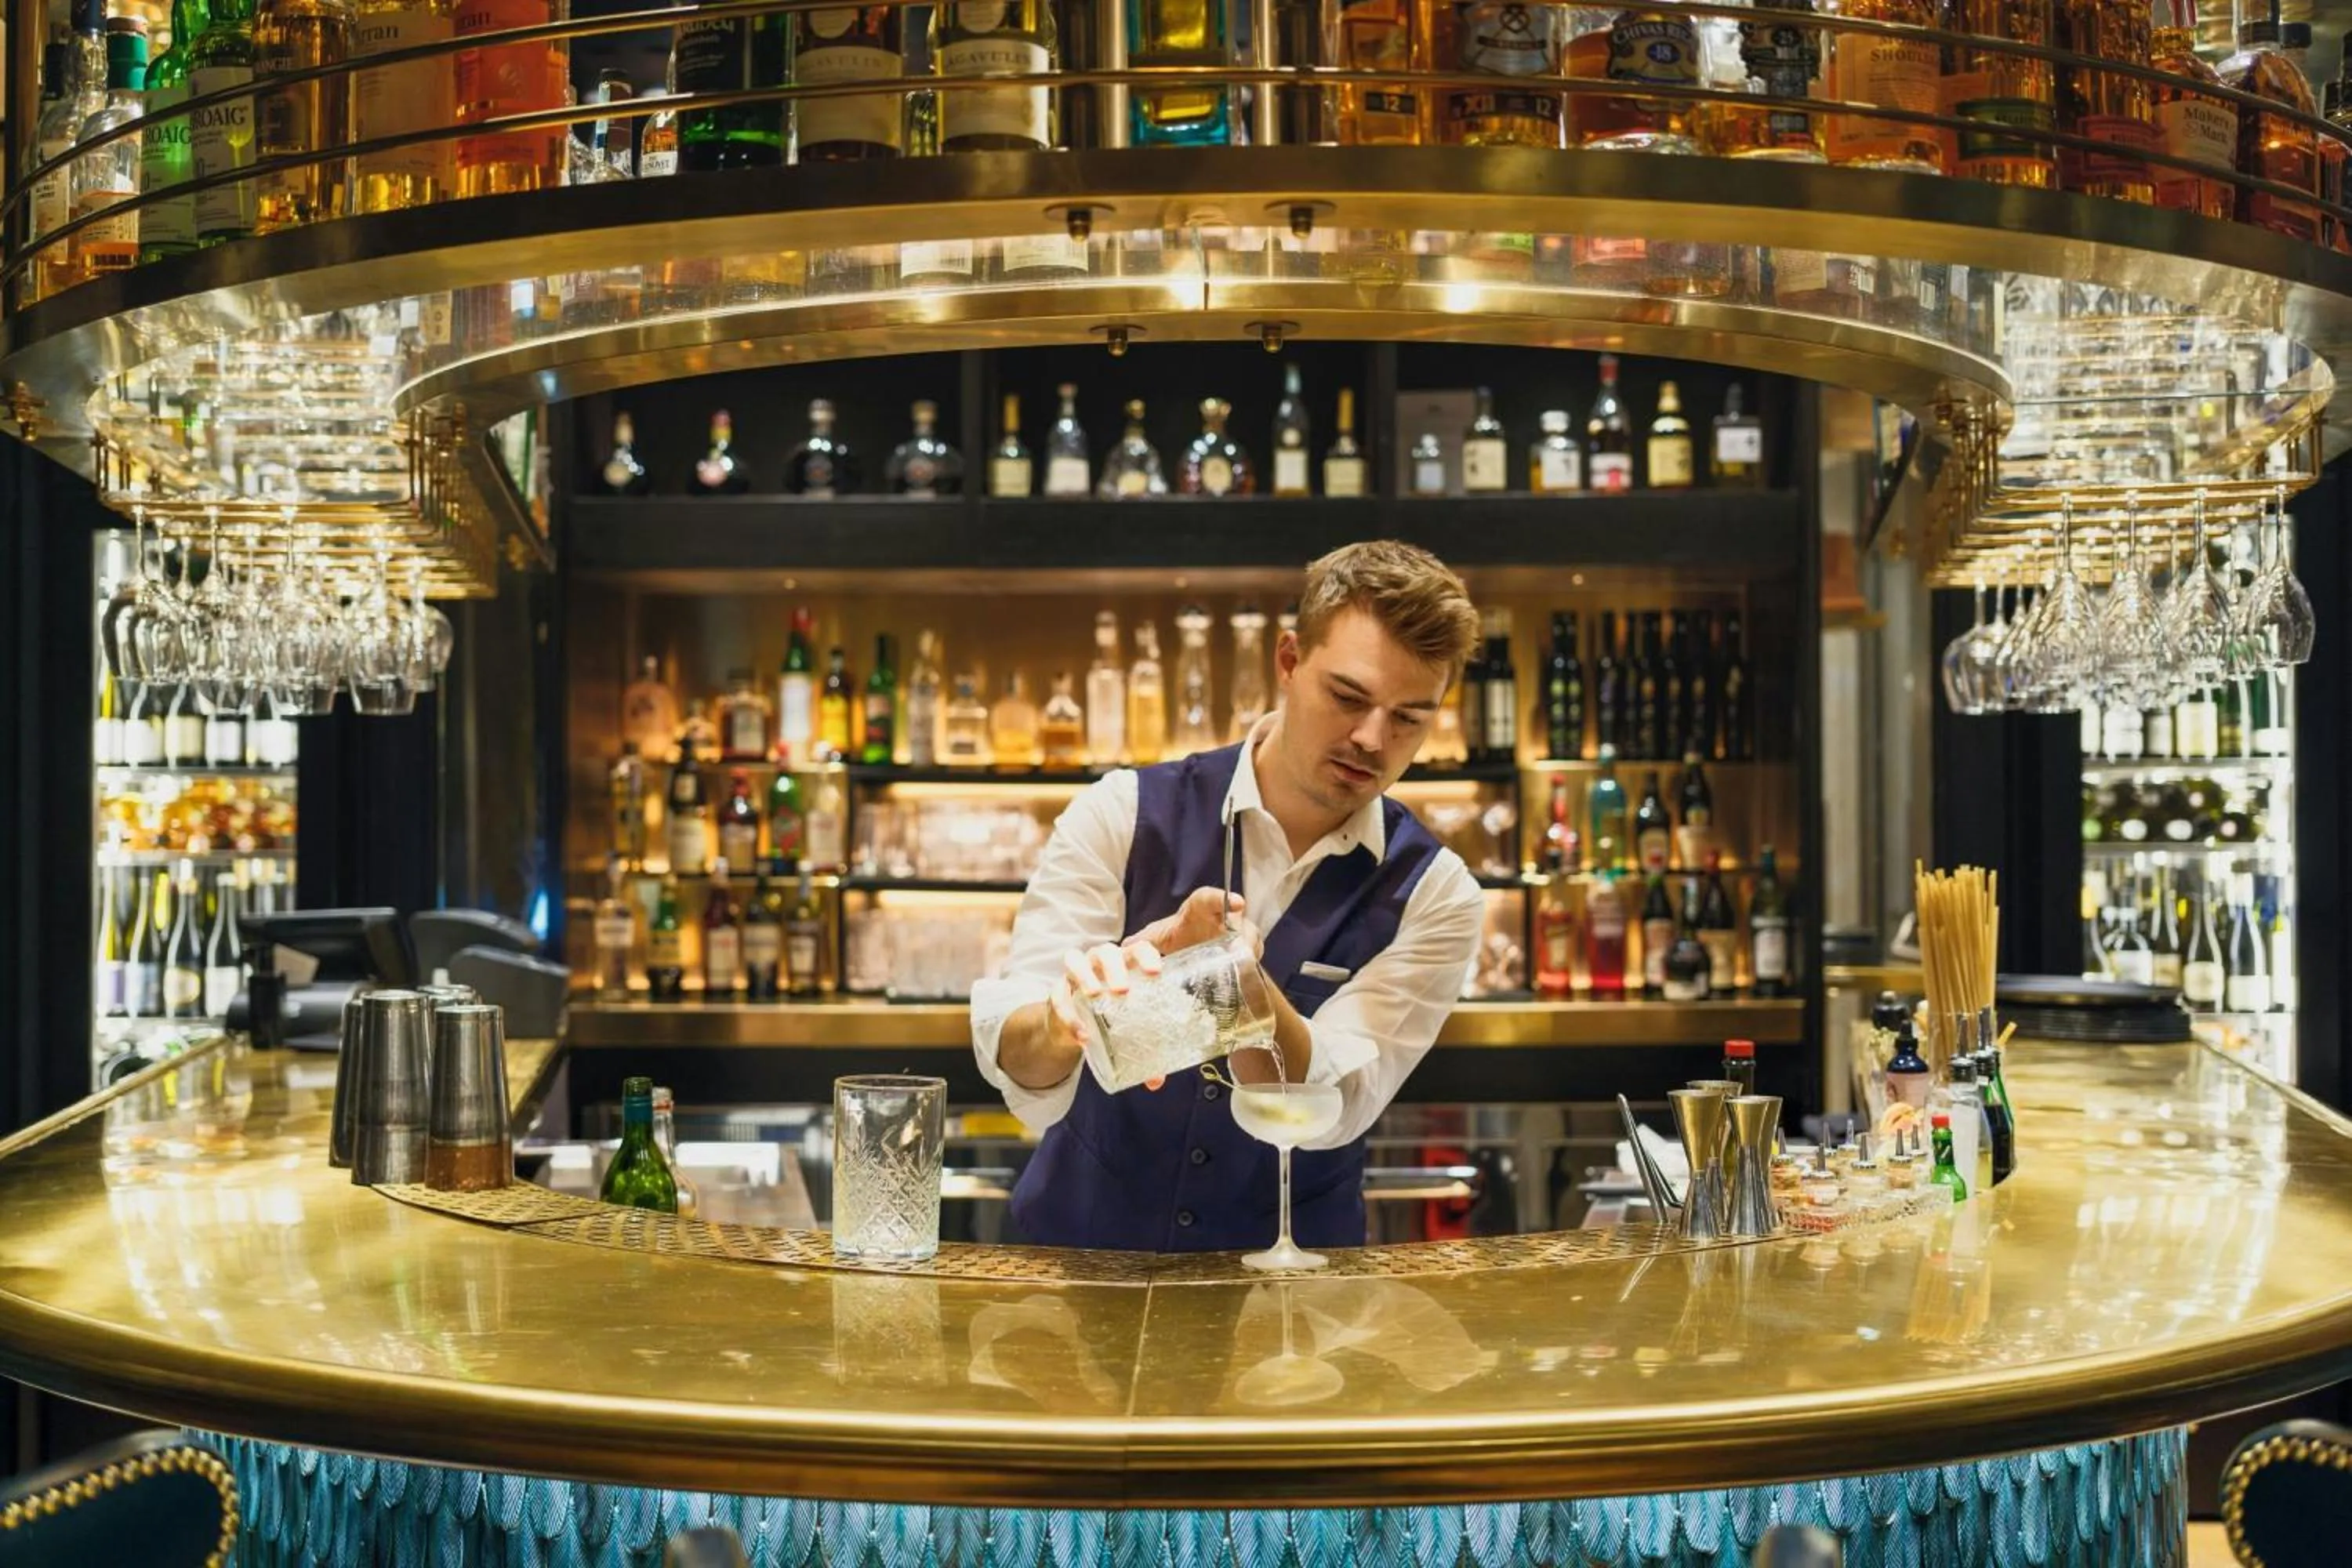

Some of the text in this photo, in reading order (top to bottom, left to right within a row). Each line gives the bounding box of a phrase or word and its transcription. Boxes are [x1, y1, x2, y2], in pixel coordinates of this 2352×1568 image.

[1613, 23, 1664, 45] CHIVAS
[1656, 44, 1672, 62] 18
[1382, 95, 1399, 112] 12
[1536, 97, 1552, 117] 12
